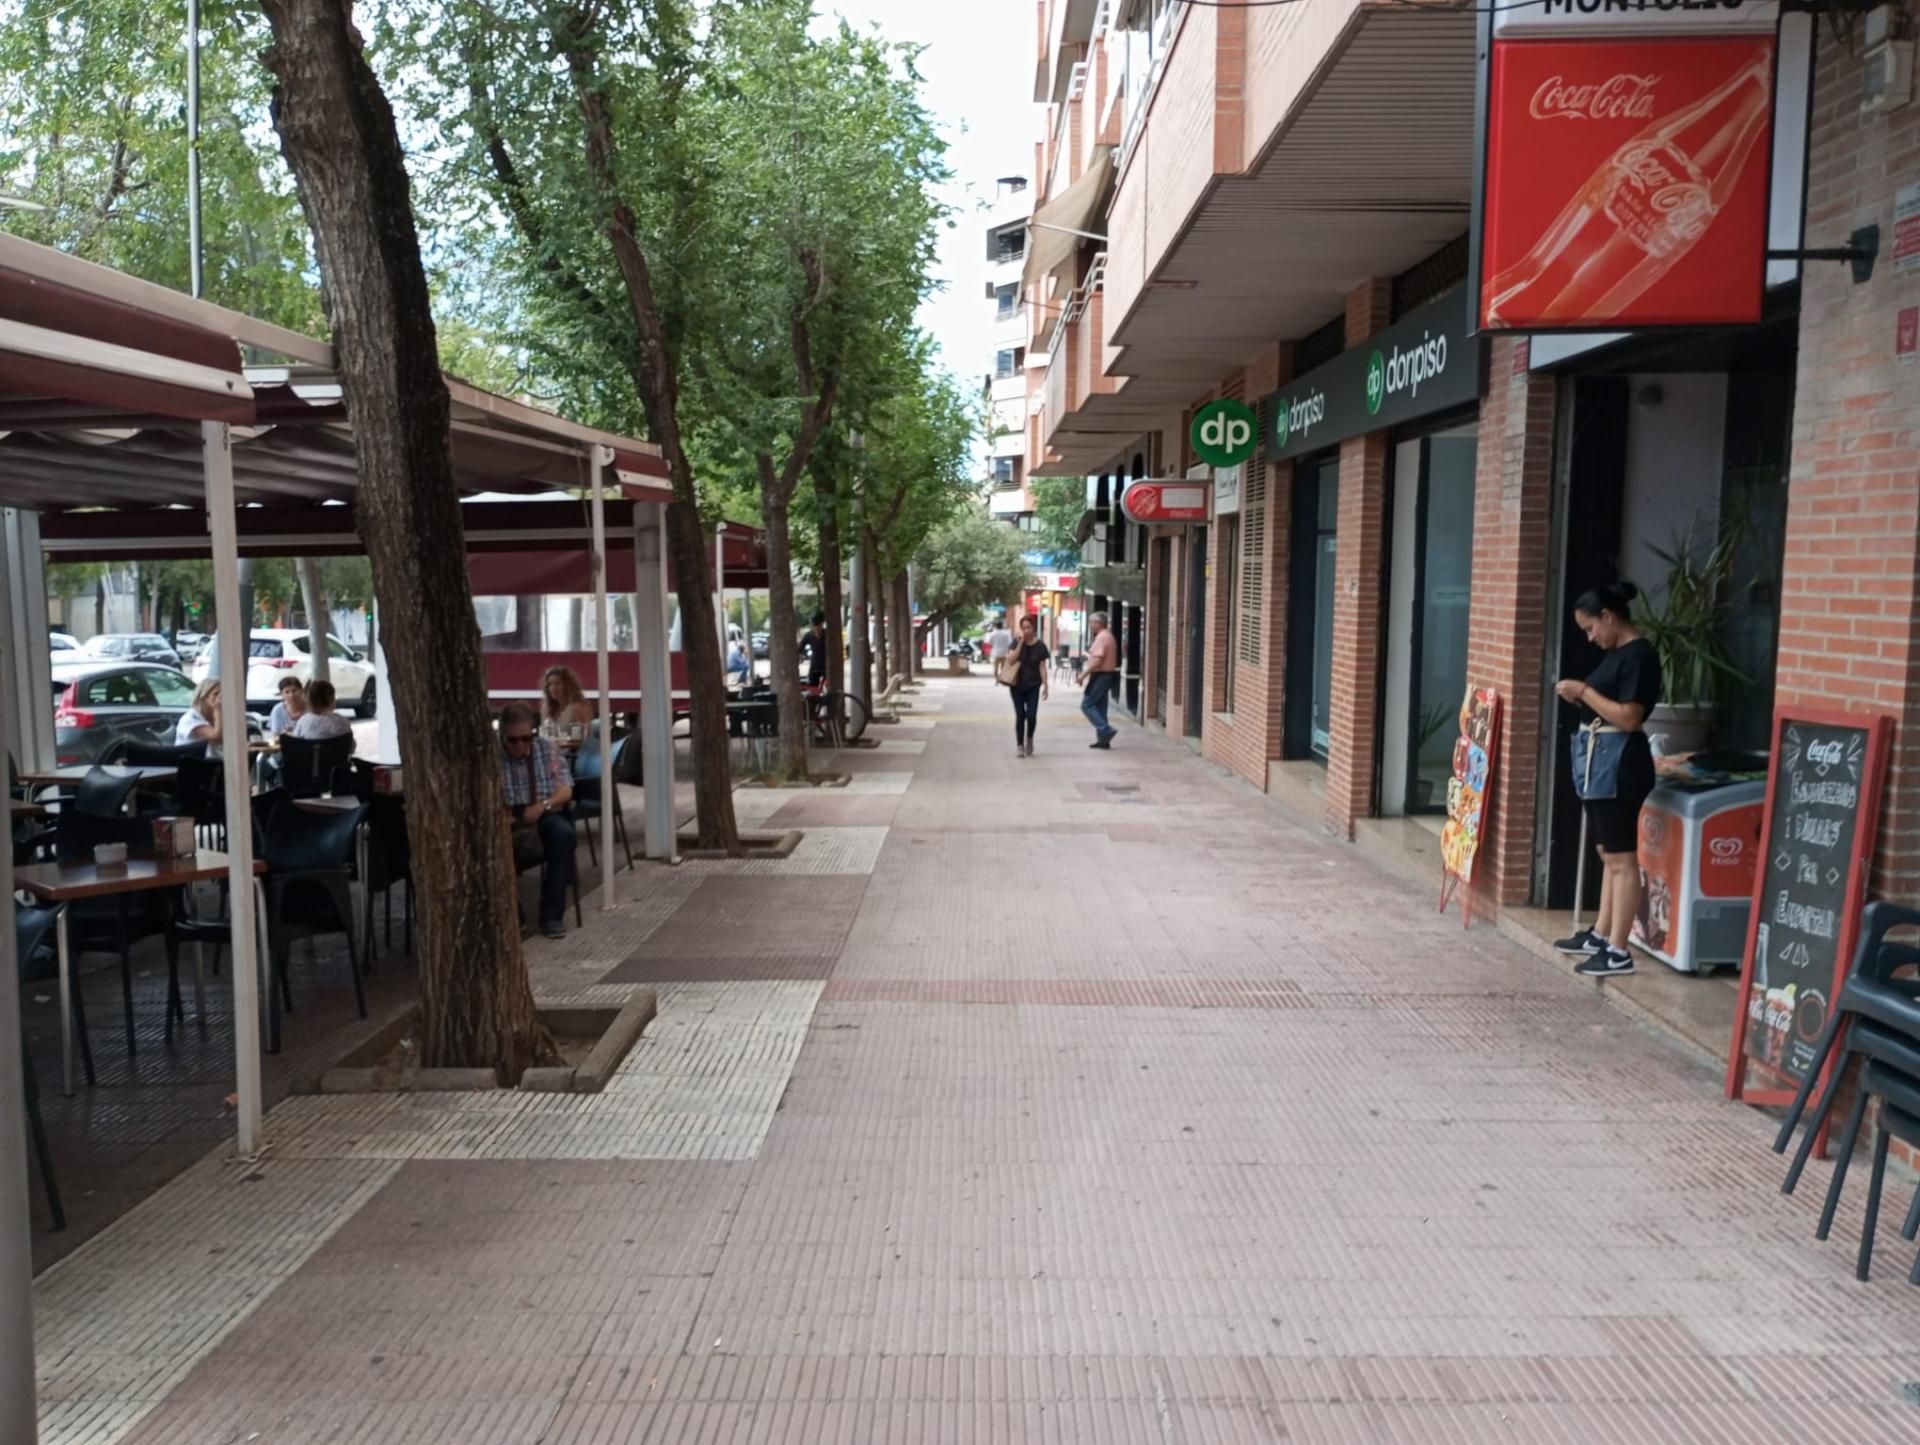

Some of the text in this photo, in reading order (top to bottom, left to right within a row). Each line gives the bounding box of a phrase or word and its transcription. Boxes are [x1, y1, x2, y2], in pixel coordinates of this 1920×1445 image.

[1529, 74, 1663, 119] Coca-Cola
[1386, 330, 1447, 399] donpiso
[1200, 411, 1251, 454] dp
[1289, 387, 1325, 438] donpiso
[1711, 857, 1740, 866] FRIGO
